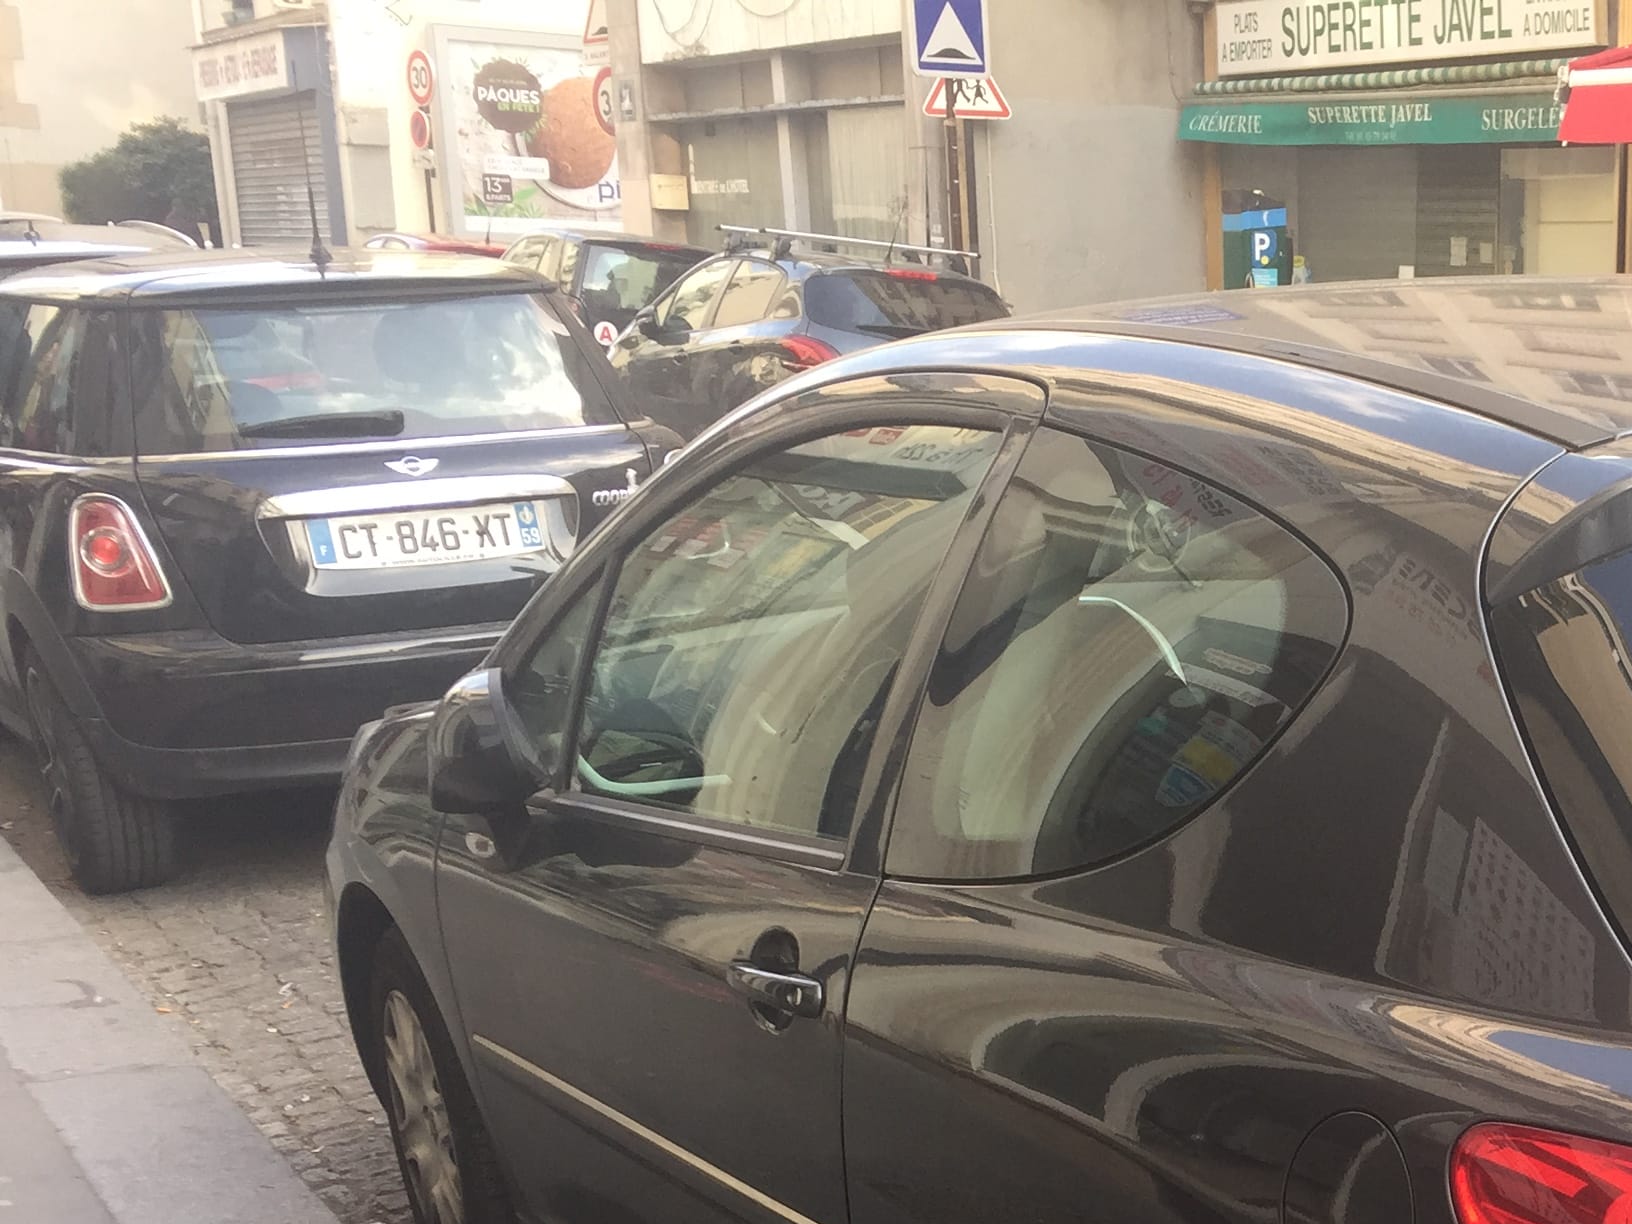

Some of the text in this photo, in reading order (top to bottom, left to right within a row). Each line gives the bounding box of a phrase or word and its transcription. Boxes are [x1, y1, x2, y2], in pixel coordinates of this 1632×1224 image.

[1233, 12, 1259, 34] PLATS
[1280, 0, 1513, 58] SUPERETTE JAVEL
[1523, 8, 1590, 36] A DOMICILE
[1221, 38, 1273, 63] A EMPORTER
[411, 66, 428, 90] 30
[1189, 110, 1262, 134] CRÉMERIE
[1308, 103, 1432, 128] SUPERETTE JAVEL
[485, 176, 503, 193] 13
[1254, 232, 1270, 261] P
[600, 326, 612, 341] A
[338, 513, 511, 559] CT-846-XT
[521, 526, 542, 544] 59
[319, 545, 328, 557] F
